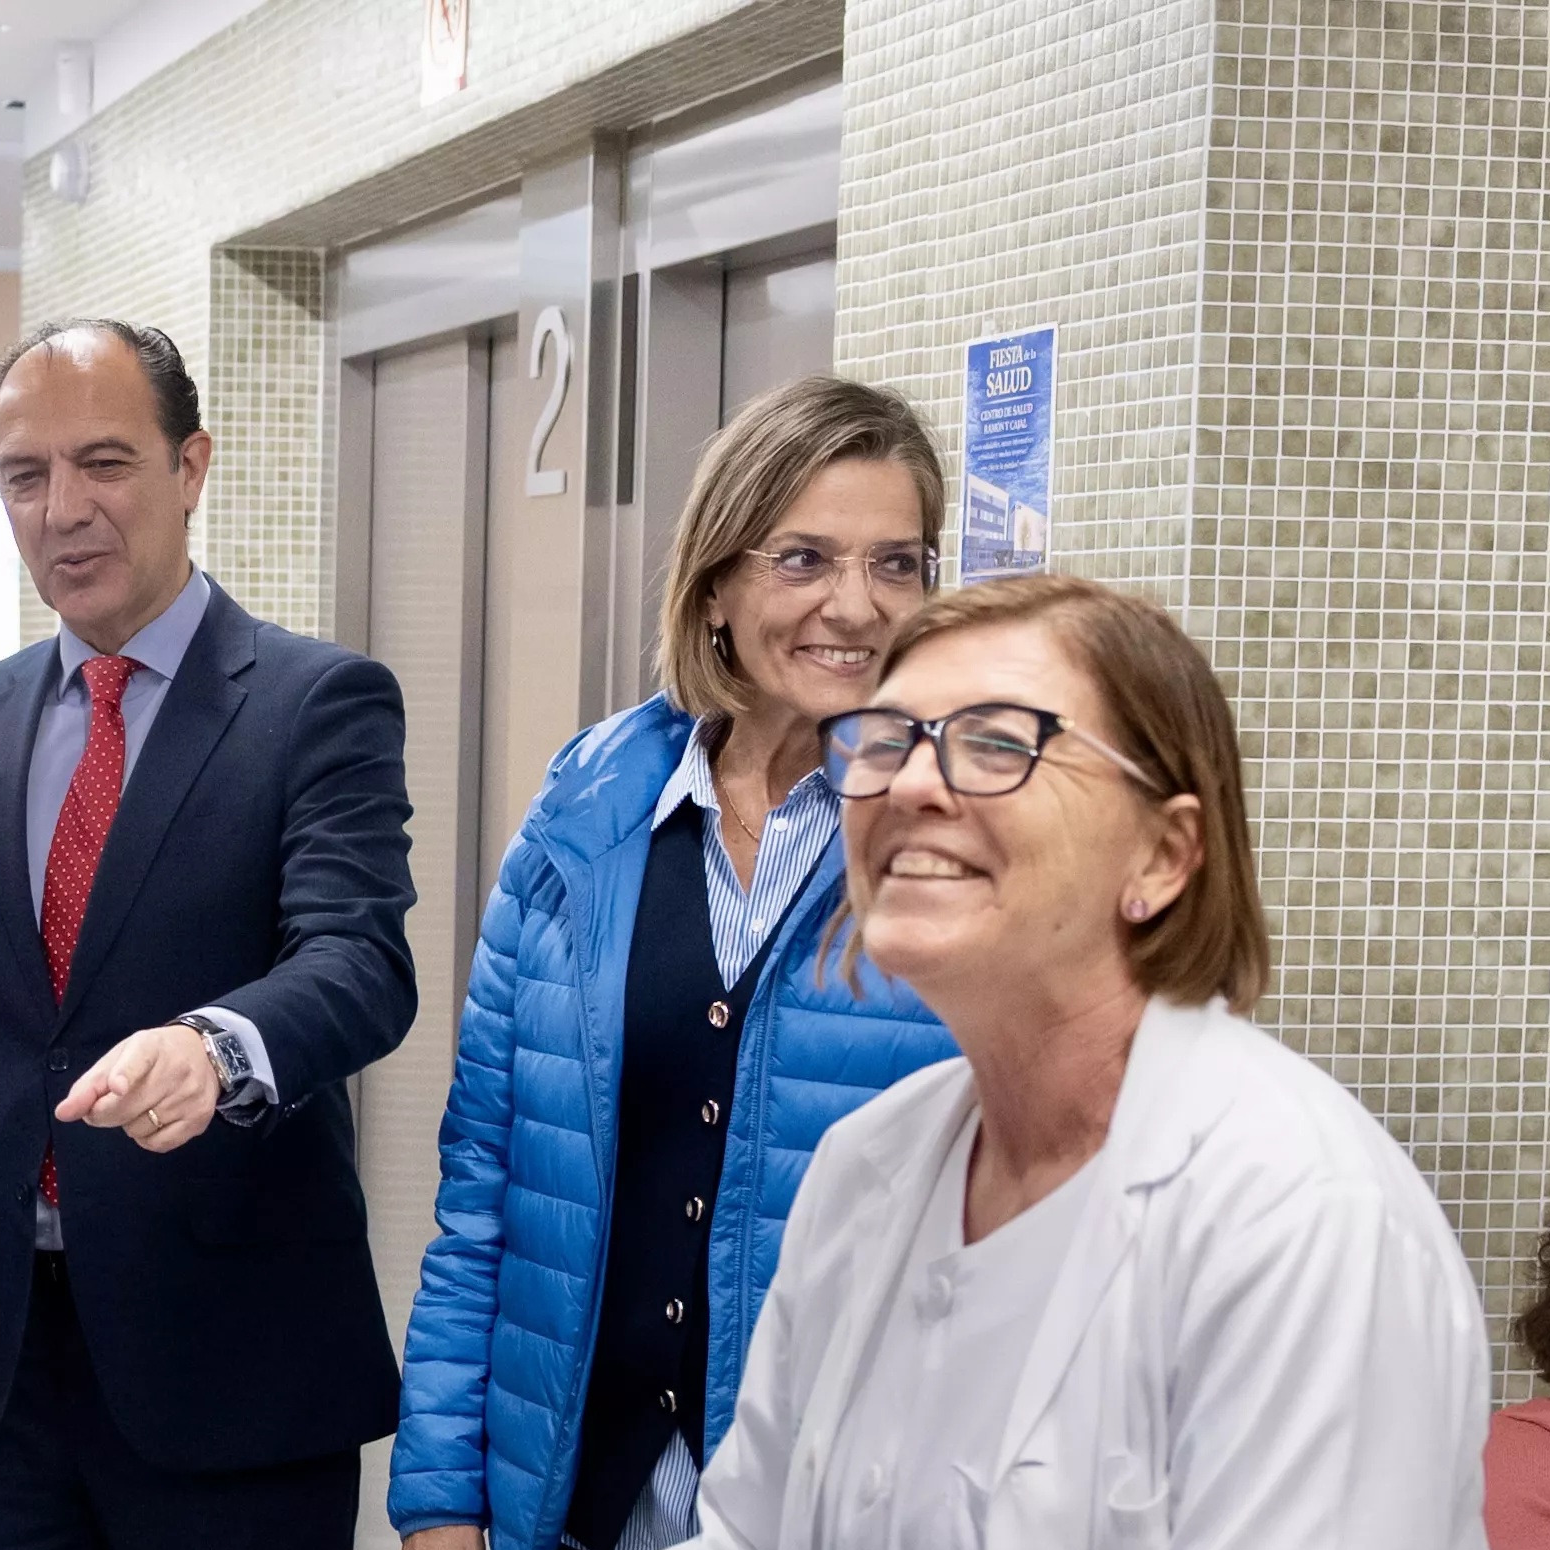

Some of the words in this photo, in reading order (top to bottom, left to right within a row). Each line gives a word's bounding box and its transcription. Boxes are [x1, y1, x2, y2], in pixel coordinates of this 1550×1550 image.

[990, 345, 1023, 369] FIESTA
[987, 367, 1032, 397] SALUD
[525, 304, 574, 498] 2
[1012, 402, 1034, 416] SALUD
